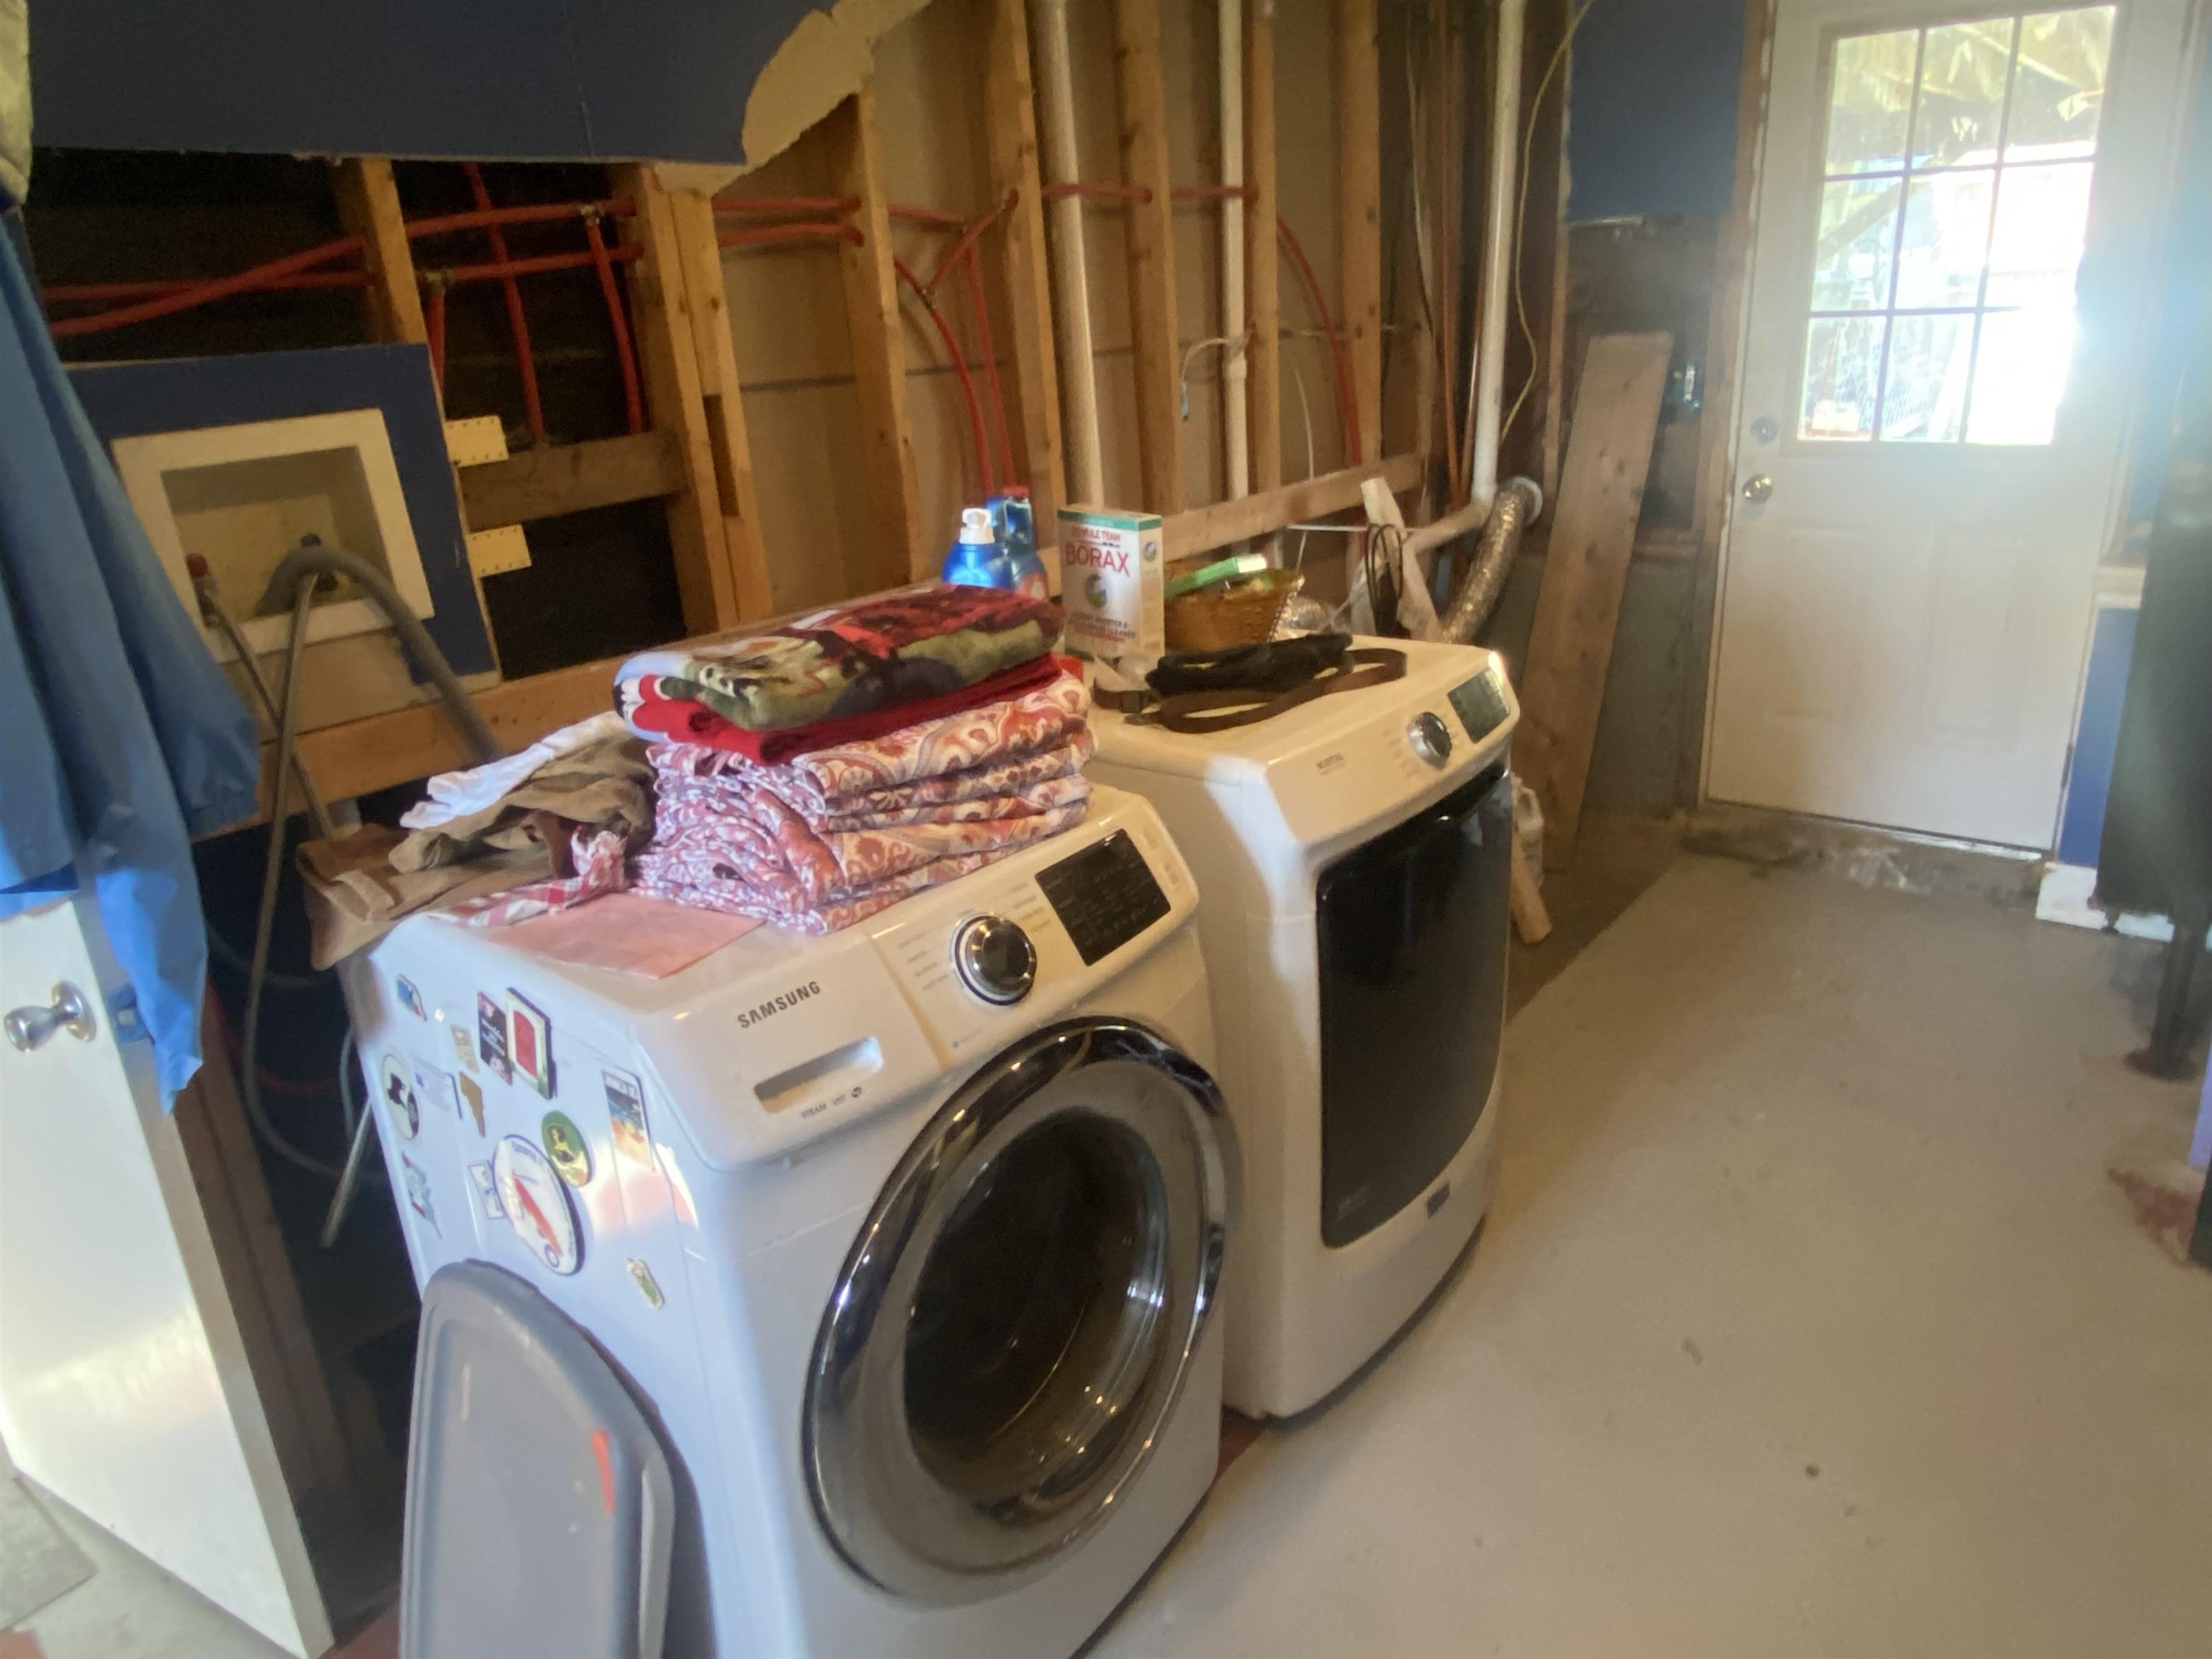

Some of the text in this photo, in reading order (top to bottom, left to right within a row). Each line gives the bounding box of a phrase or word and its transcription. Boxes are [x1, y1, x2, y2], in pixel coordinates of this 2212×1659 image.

[1102, 531, 1121, 541] TEAM
[1065, 542, 1130, 577] BORAX
[737, 981, 821, 1028] SAMSUNG
